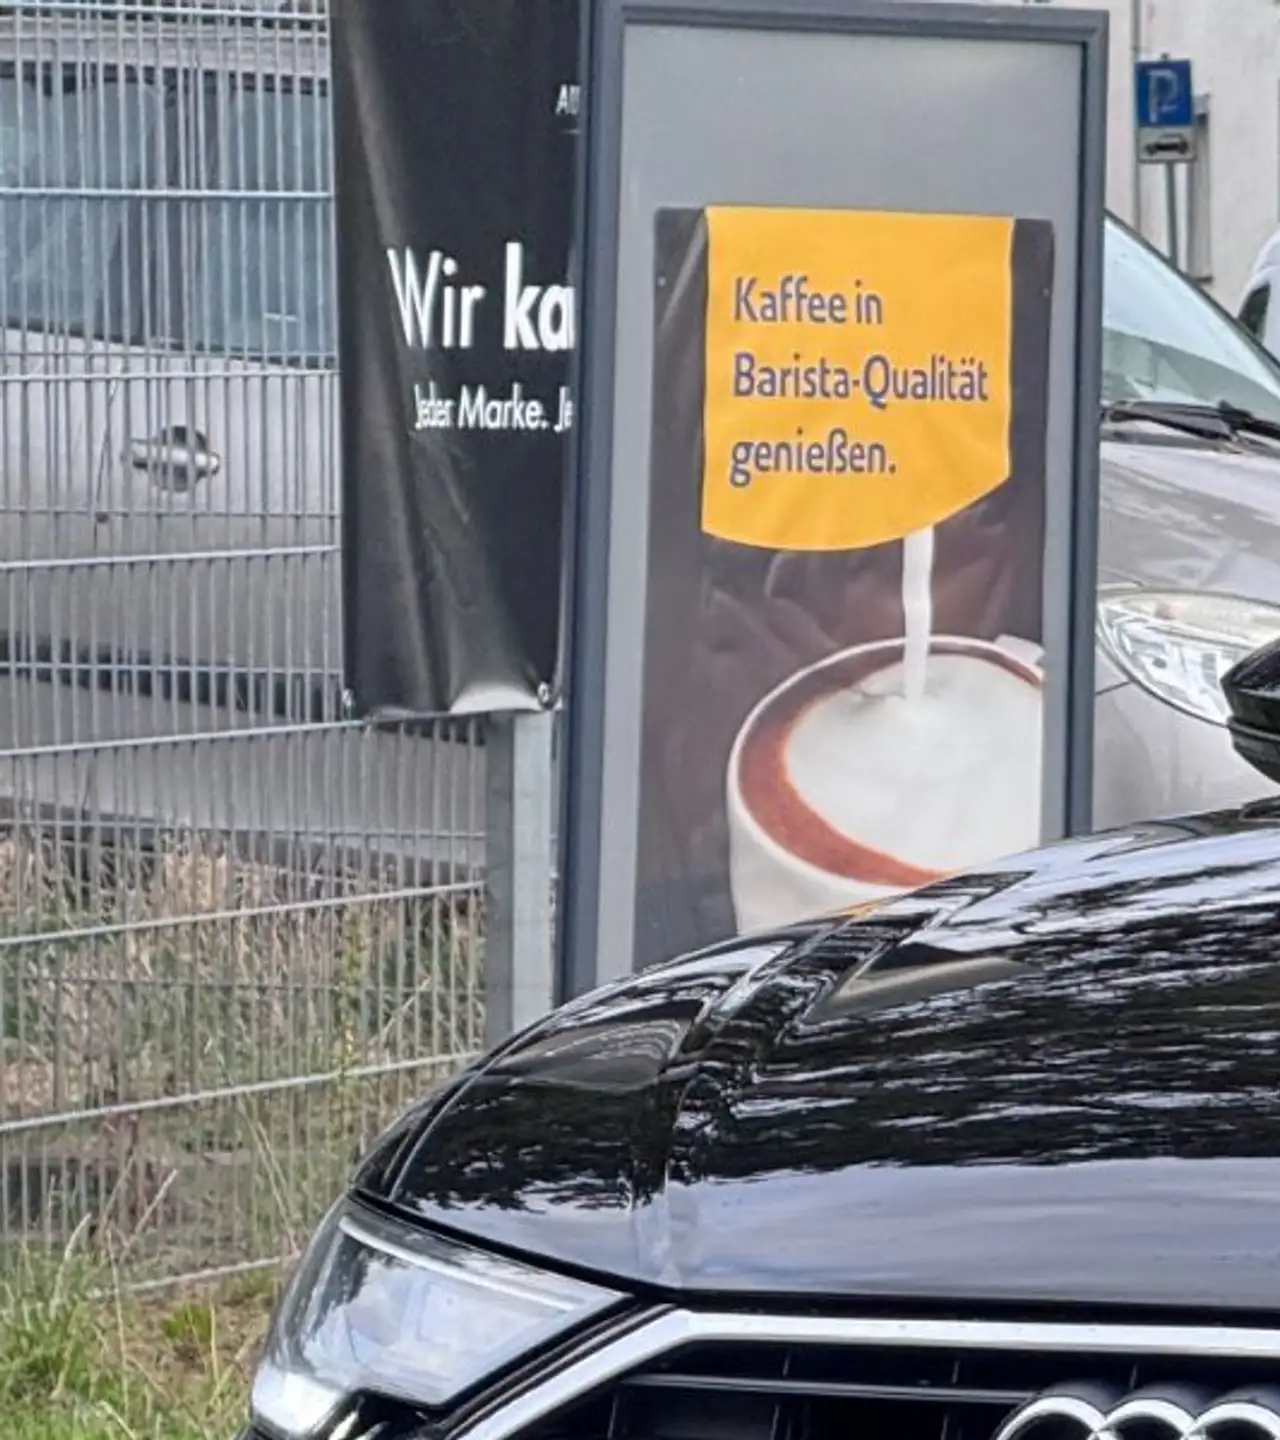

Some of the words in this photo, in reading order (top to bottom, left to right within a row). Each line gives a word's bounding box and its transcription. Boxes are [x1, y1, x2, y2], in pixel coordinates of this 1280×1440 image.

[1148, 69, 1178, 123] P
[387, 245, 485, 350] Wir
[734, 275, 848, 323] Kaffee
[854, 279, 884, 325] in
[414, 381, 456, 430] Jeder
[458, 381, 549, 430] Marke.
[733, 351, 989, 410] Barista-Qualität
[729, 427, 897, 488] genießen.
